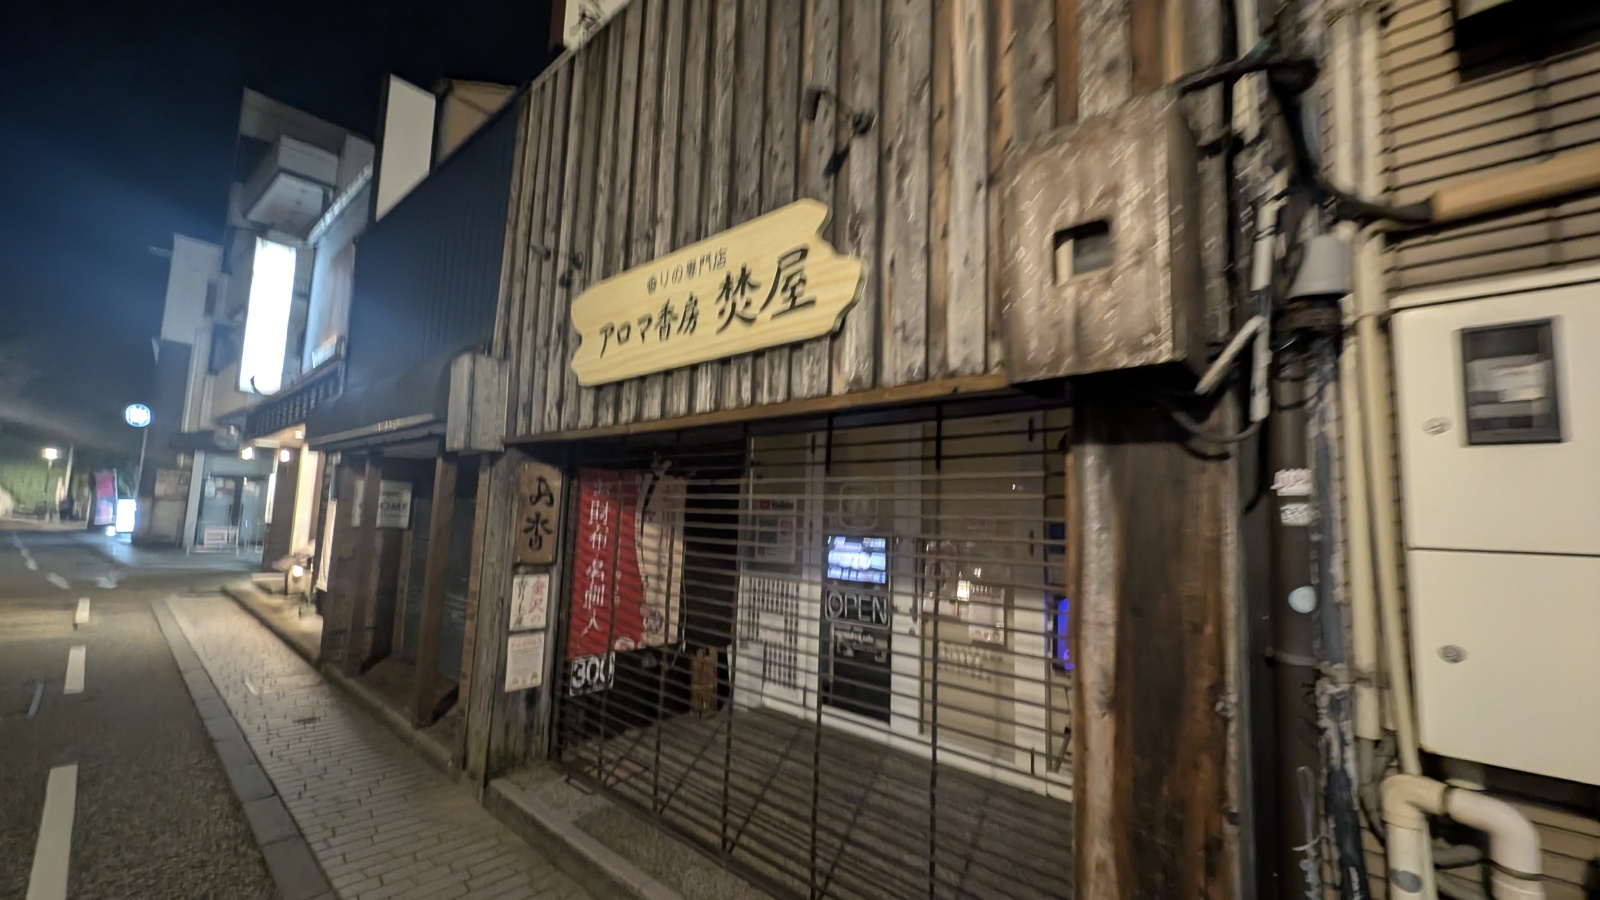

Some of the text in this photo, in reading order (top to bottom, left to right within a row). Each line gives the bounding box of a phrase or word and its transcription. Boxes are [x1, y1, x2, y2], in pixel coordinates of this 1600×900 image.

[647, 247, 728, 294] 香りの専門店
[598, 244, 817, 359] アロマ香房 焚屋
[827, 591, 888, 625] OPEN
